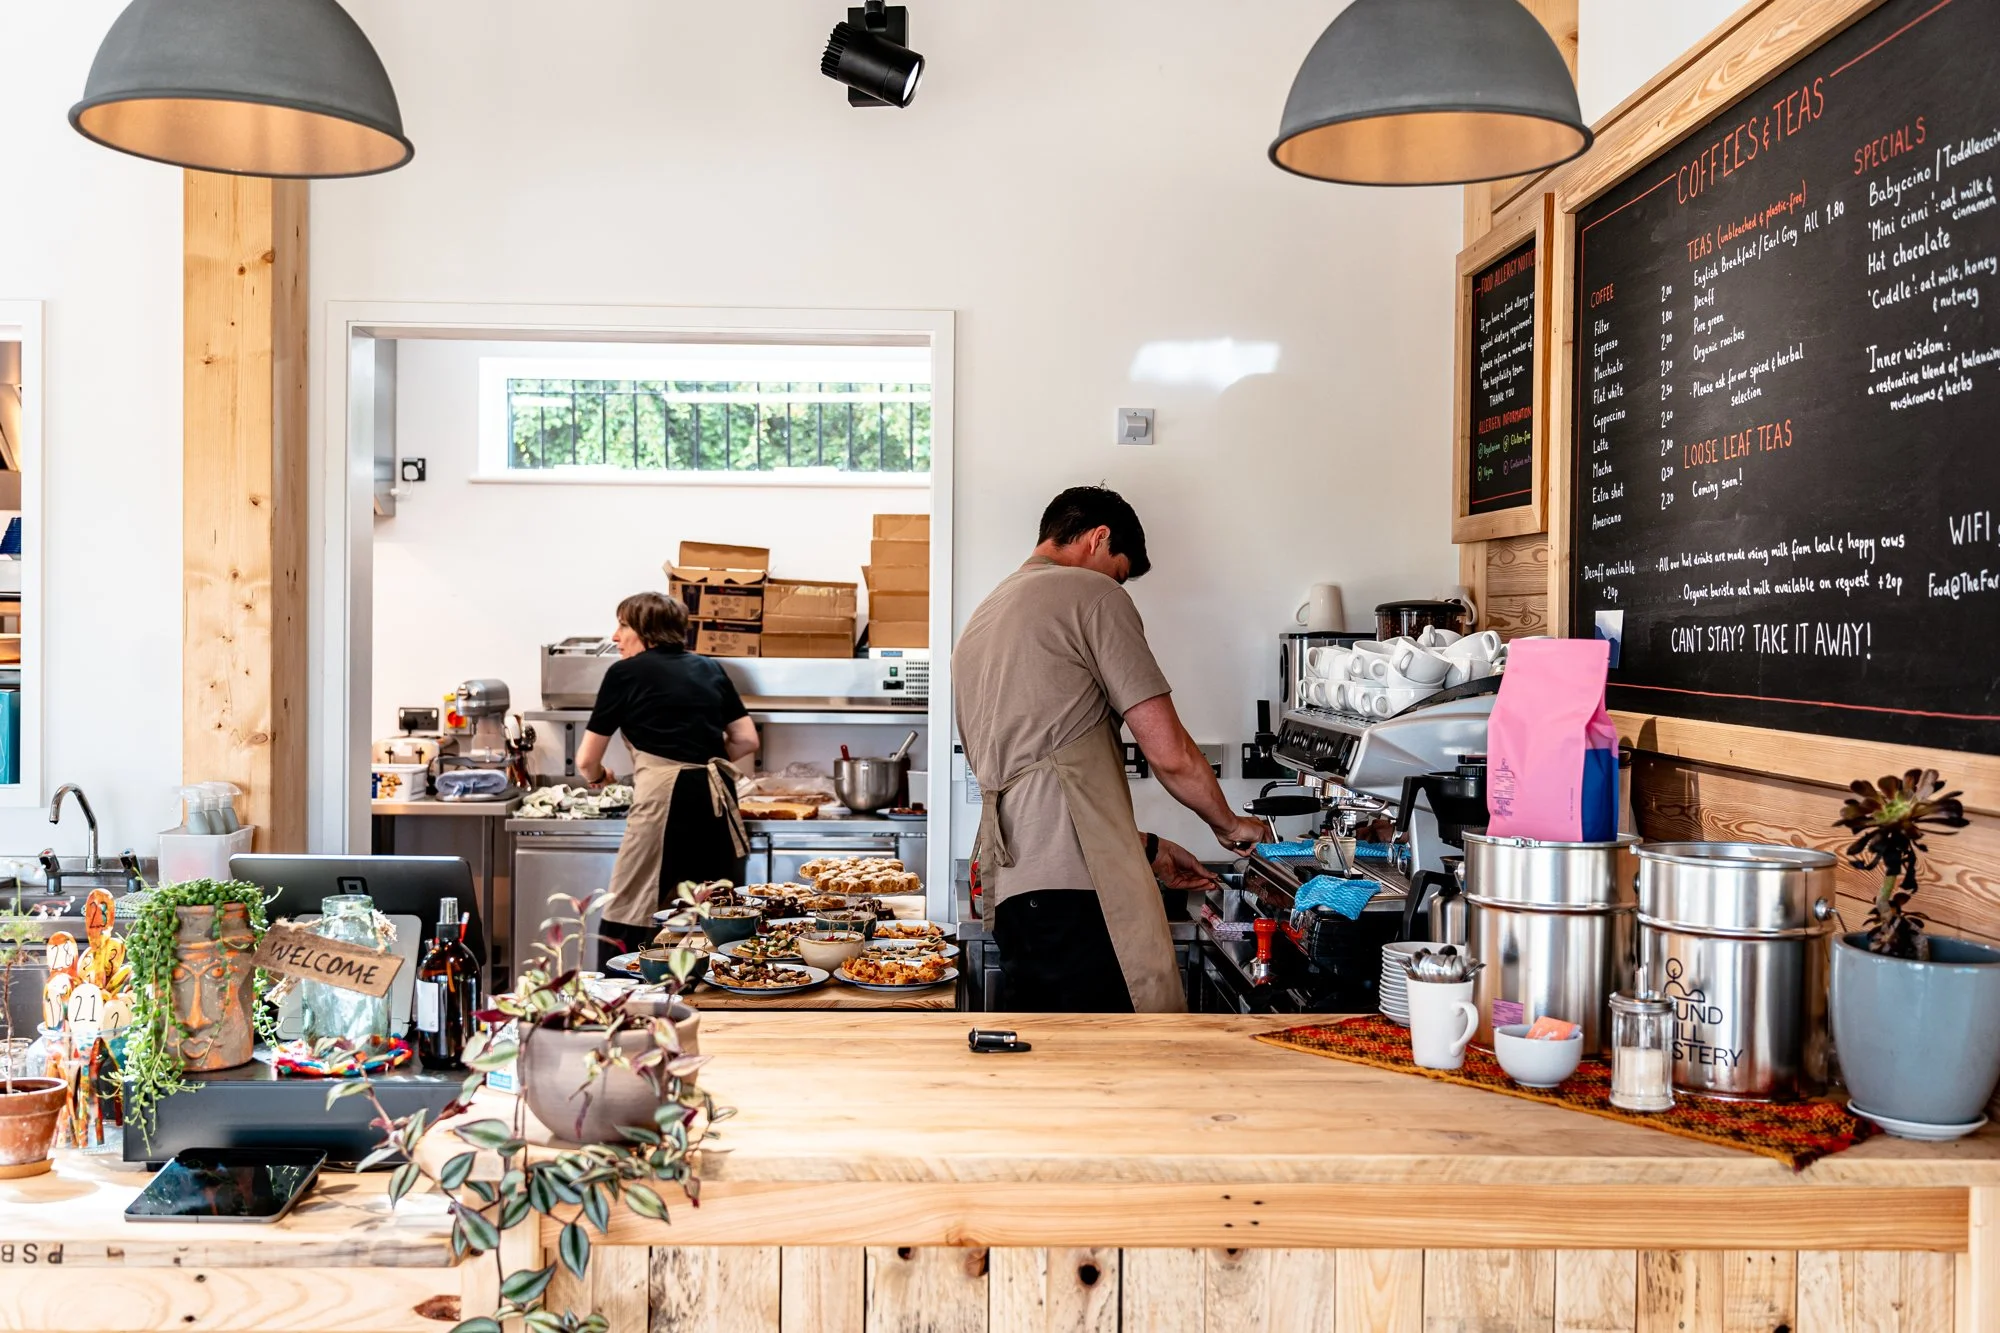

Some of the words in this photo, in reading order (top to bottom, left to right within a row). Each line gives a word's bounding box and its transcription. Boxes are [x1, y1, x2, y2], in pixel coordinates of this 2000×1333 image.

[1678, 117, 1758, 205] COFFEES
[1762, 116, 1770, 151] &
[1773, 77, 1825, 142] TEAS
[1854, 116, 1926, 175] SPECIALS
[1869, 167, 1931, 207] Babyccino
[1960, 178, 1983, 201] milk
[1687, 232, 1712, 262] TEAS
[1766, 179, 1807, 229] plastic-free)
[1952, 195, 1997, 220] cinnamon
[1693, 262, 1718, 289] English
[1781, 225, 1798, 247] Grey
[1804, 210, 1819, 233] All
[1826, 201, 1845, 225] 1.80
[1868, 250, 1886, 275] Hot
[1893, 226, 1951, 267] chocolate
[1920, 270, 1936, 292] oat
[1964, 256, 1998, 275] honey
[1590, 283, 1614, 308] COFFEE
[1693, 288, 1715, 311] Decaff
[1940, 287, 1980, 308] nutmeg
[1593, 319, 1610, 337] Filter
[1693, 317, 1706, 335] Pure
[1707, 314, 1724, 335] green
[1593, 339, 1619, 362] Espresso
[1693, 342, 1718, 363] Organic
[1720, 326, 1745, 348] rooibos
[1593, 358, 1624, 382] Macchiato
[1715, 372, 1726, 389] ask
[1727, 368, 1737, 391] for
[1737, 369, 1748, 381] our
[1749, 359, 1770, 384] spiced
[1777, 342, 1803, 367] herbal
[1867, 386, 1875, 396] a
[1876, 371, 1919, 394] restorative
[1922, 361, 1946, 380] blend
[1948, 356, 1959, 378] of
[1961, 347, 2000, 370] balancin
[1489, 391, 1505, 407] THANK
[1505, 387, 1515, 399] YOU
[1593, 386, 1606, 405] Flat
[1607, 382, 1624, 400] white
[1731, 386, 1762, 407] selection
[1890, 388, 1936, 411] mushrooms
[1945, 375, 1973, 396] herbs
[1593, 409, 1626, 433] Cappuccino
[1593, 440, 1609, 454] Latte
[1684, 439, 1718, 469] LOOSE
[1723, 428, 1752, 460] LEAF
[1757, 418, 1792, 451] TEAS
[1592, 460, 1612, 479] Mocha
[1592, 487, 1610, 504] Extra
[1610, 482, 1624, 500] shot
[1692, 480, 1719, 500] Coming
[1721, 467, 1743, 490] soon!
[1592, 514, 1622, 530] Americano
[1949, 510, 1990, 545] WIFI
[1659, 556, 1669, 572] All
[1670, 561, 1680, 570] our
[1681, 552, 1692, 567] hot
[1693, 551, 1713, 565] drinks
[1714, 552, 1726, 562] are
[1727, 548, 1746, 561] made
[1747, 547, 1769, 566] using
[1771, 541, 1788, 557] milk
[1792, 538, 1812, 561] from
[1815, 535, 1835, 553] local
[1847, 531, 1875, 565] happy
[1881, 533, 1905, 548] cows
[1584, 563, 1605, 583] Decaff
[1605, 560, 1636, 577] available
[1602, 586, 1619, 603] +20p
[1683, 583, 1709, 606] Organic
[1710, 580, 1734, 598] barista
[1737, 578, 1751, 596] oat
[1753, 579, 1771, 595] milk
[1774, 577, 1815, 594] available
[1819, 578, 1832, 589] on
[1835, 568, 1870, 597] request
[1878, 572, 1902, 597] +20p
[1671, 624, 1703, 653] CAN'T
[1707, 624, 1745, 653] STAY?
[1753, 623, 1788, 654] TAKE
[1795, 622, 1809, 654] IT
[1815, 621, 1871, 660] AWAY!
[270, 941, 380, 985] WELCOME
[74, 994, 97, 1023] 21
